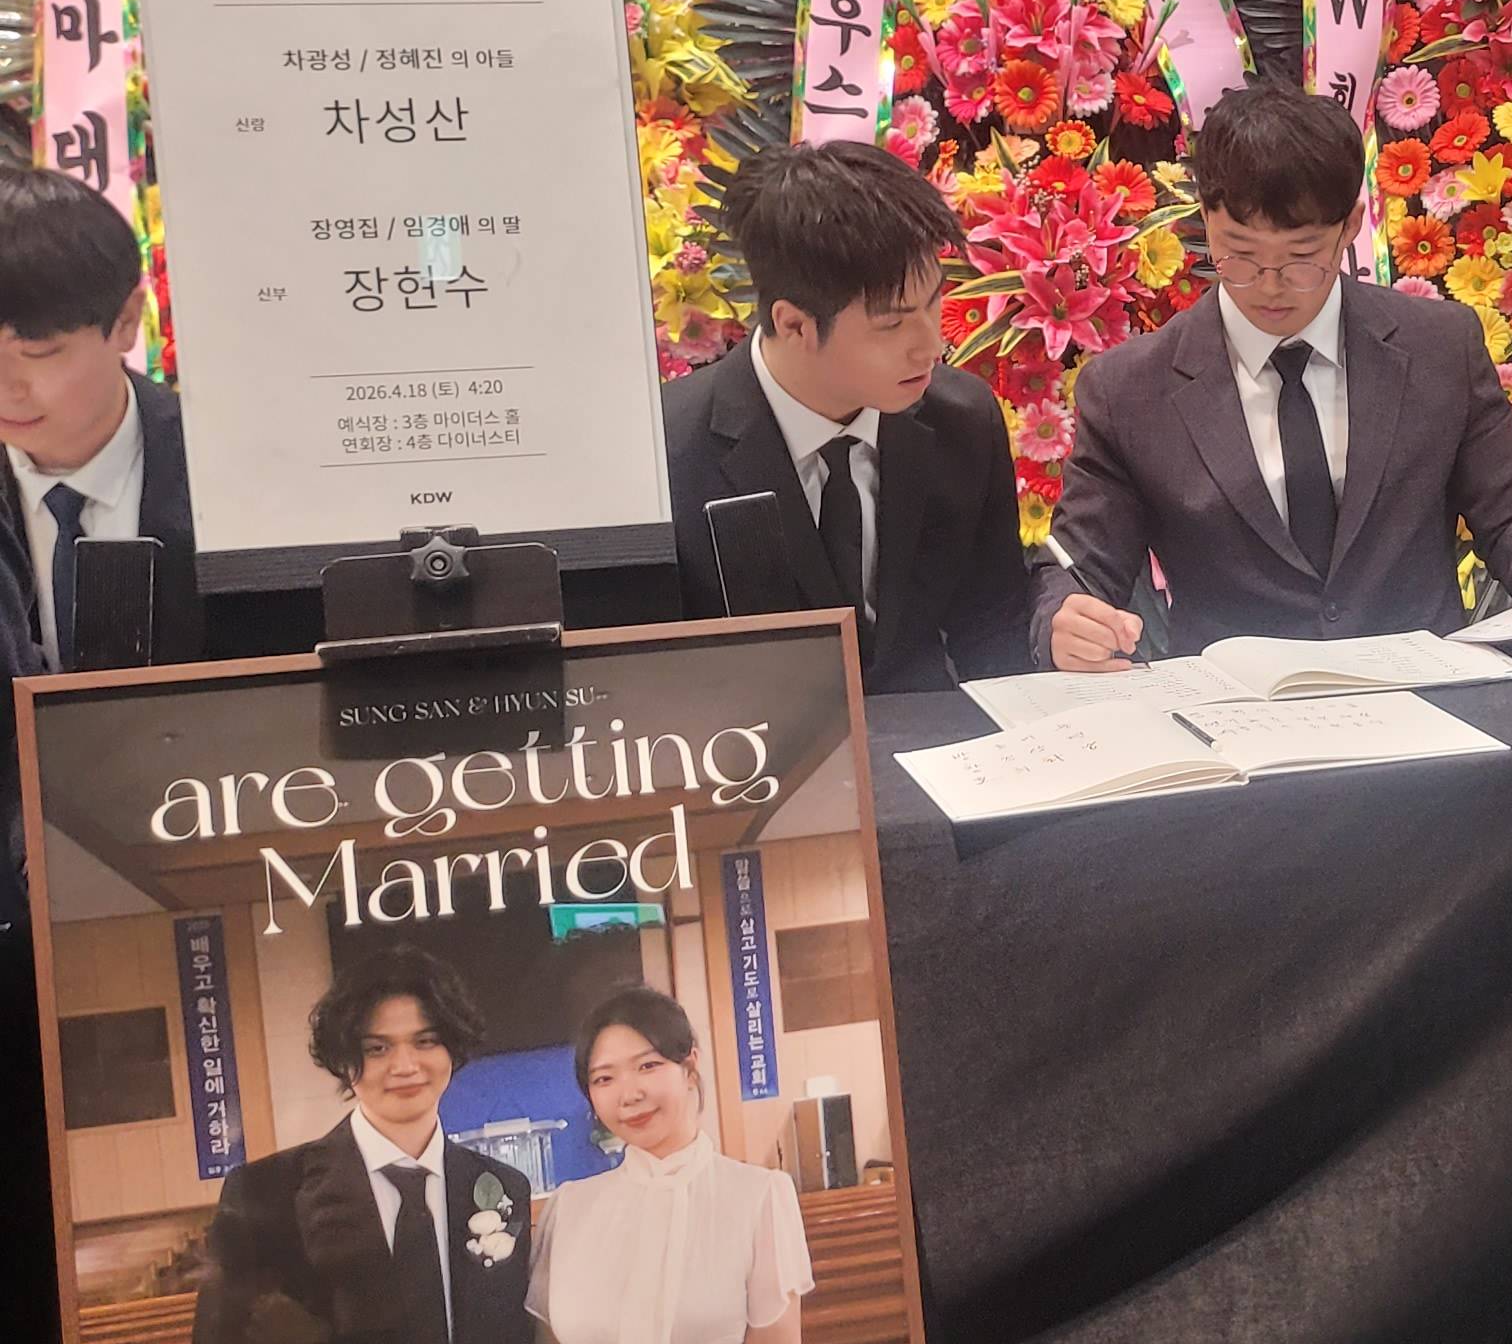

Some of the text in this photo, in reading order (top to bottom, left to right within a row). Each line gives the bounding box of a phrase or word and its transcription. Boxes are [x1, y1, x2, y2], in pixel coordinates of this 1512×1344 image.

[281, 48, 352, 72] 차광성
[375, 47, 443, 71] 정혜진
[475, 48, 515, 69] 아들
[235, 117, 265, 133] 신랑
[323, 96, 470, 144] 차성산
[310, 217, 379, 241] 장영집
[403, 214, 470, 238] 임경애
[502, 215, 521, 235] 딸
[257, 287, 288, 302] 신부
[345, 383, 428, 401] 2026.4.18
[468, 379, 504, 396] 4:20
[337, 414, 388, 433] 예식장
[402, 412, 429, 430] 3층
[433, 409, 500, 428] 마이더스
[342, 435, 392, 454] 연회장
[406, 432, 433, 451] 4층
[438, 429, 521, 449] 다이너스티
[410, 491, 453, 505] KDW
[339, 704, 408, 727] SUNG
[414, 698, 461, 721] SAN
[468, 695, 488, 715] &
[494, 690, 558, 714] HYUN
[150, 718, 780, 843] are getting
[261, 805, 695, 936] Married
[203, 1058, 226, 1095] 일에
[207, 1101, 232, 1156] 거하라
